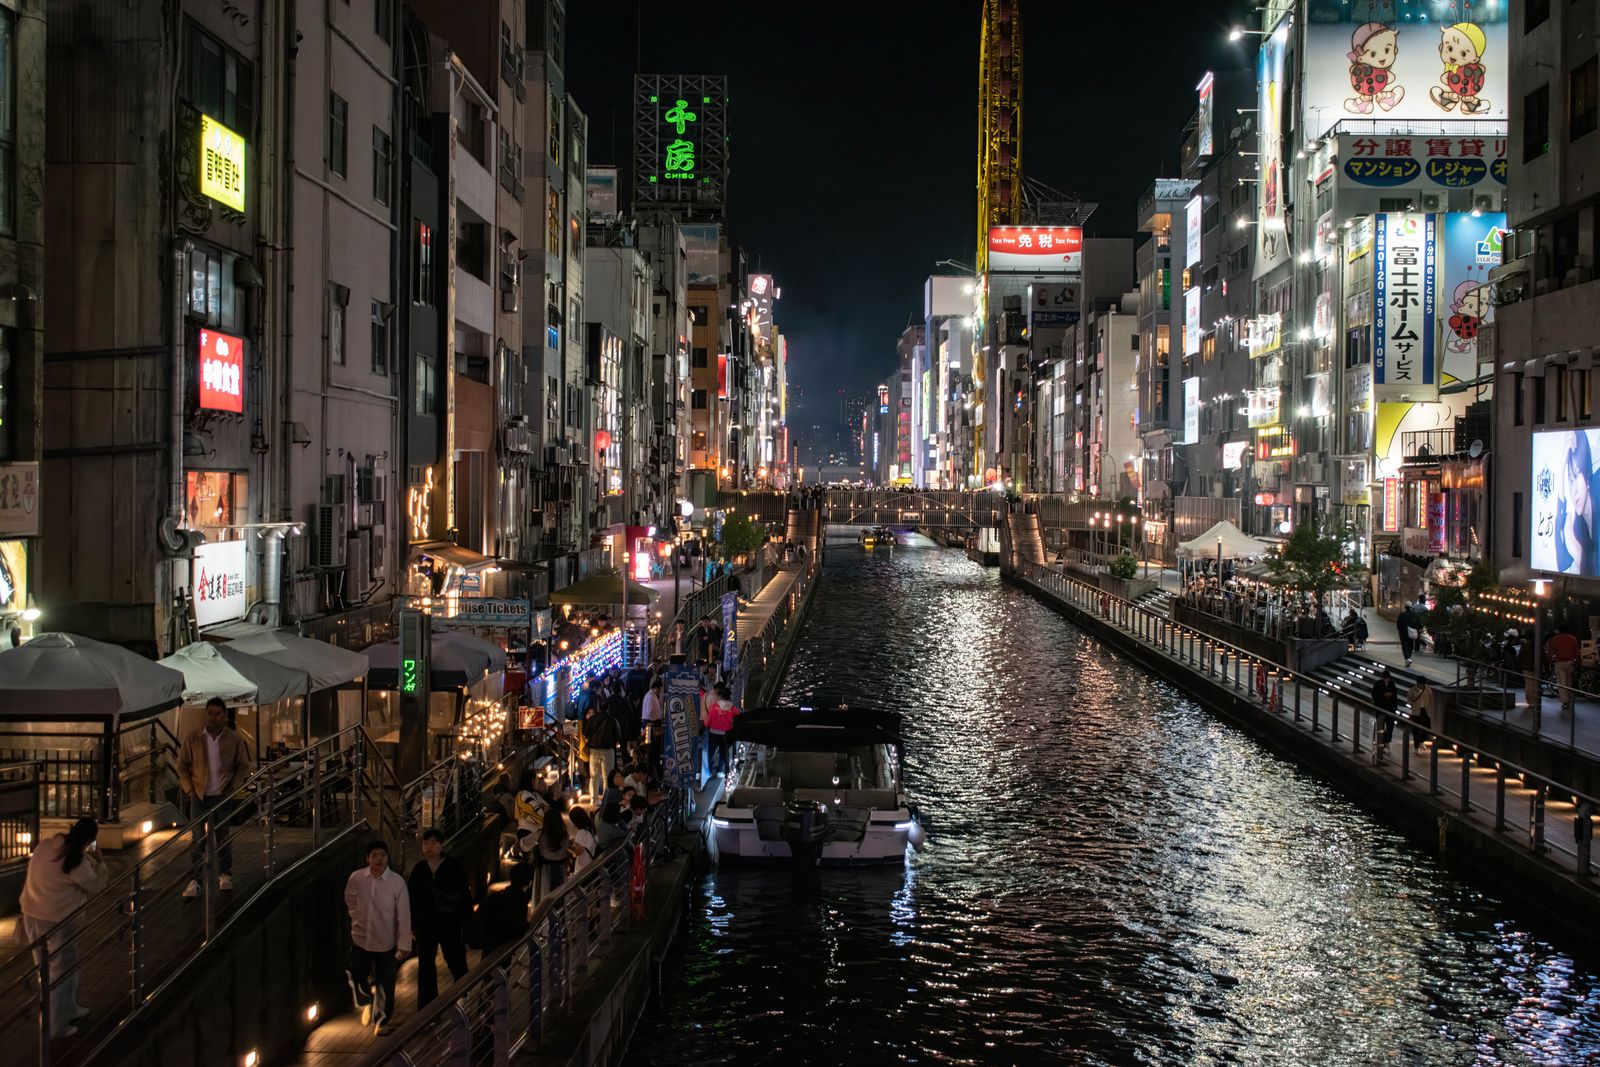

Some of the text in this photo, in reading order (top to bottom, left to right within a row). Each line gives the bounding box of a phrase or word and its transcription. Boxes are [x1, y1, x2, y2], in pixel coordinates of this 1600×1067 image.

[664, 99, 697, 171] 千房
[1352, 138, 1412, 157] 分譲
[1425, 138, 1486, 157] 賃貸
[1349, 161, 1418, 177] マンション
[1431, 161, 1485, 177] レジャー
[1446, 177, 1470, 186] ビル
[1390, 245, 1420, 381] 富士ホームサービス
[486, 602, 527, 614] Tickets
[668, 696, 693, 775] CRUISE
